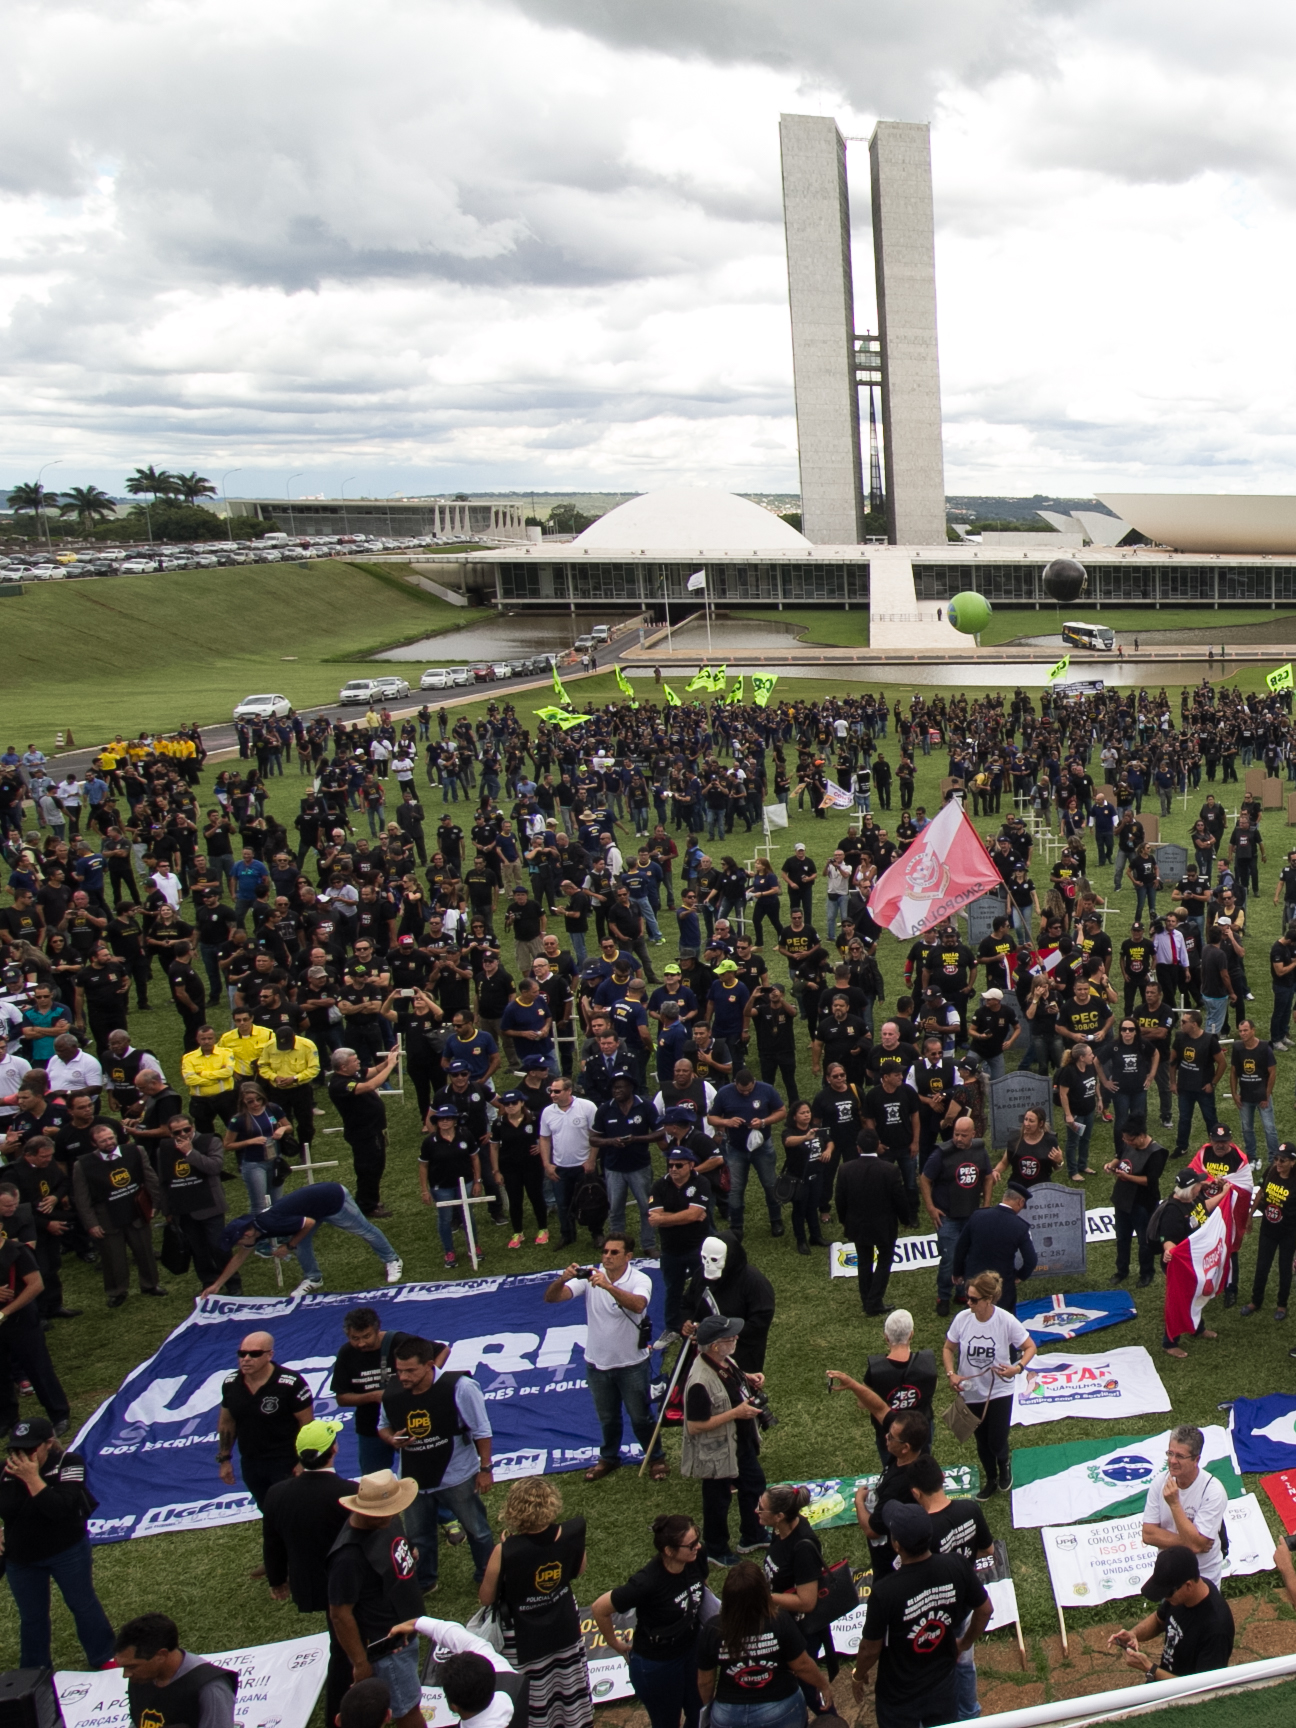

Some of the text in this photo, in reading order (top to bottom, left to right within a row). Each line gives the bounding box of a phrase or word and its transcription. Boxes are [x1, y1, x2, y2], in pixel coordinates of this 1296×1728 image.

[786, 937, 808, 946] PEC
[1071, 1011, 1098, 1023] PEC
[1074, 1021, 1098, 1030] 308/04
[1138, 1017, 1159, 1028] PEC
[1006, 1086, 1035, 1094] POLICIAL
[1021, 1159, 1037, 1168] PEC
[1206, 1162, 1230, 1172] UNIÃO
[959, 1167, 976, 1175] PEC
[1022, 1166, 1037, 1176] 287
[111, 1172, 130, 1183] UPB
[959, 1174, 977, 1184] 287
[1267, 1181, 1290, 1197] UNIÃO
[1028, 1201, 1065, 1210] POLICIAL
[1032, 1213, 1060, 1221] ENFIM
[1049, 1249, 1066, 1258] 287
[967, 1345, 996, 1358] UPB
[891, 1399, 916, 1409] 287
[1054, 1395, 1073, 1403] com
[100, 1442, 136, 1455] DOS
[519, 1384, 540, 1395] DE
[408, 1417, 430, 1428] UPB
[1228, 1507, 1246, 1515] PEC
[1230, 1513, 1248, 1521] 287
[1090, 1528, 1101, 1537] SE
[1102, 1527, 1110, 1536] O
[1056, 1537, 1078, 1546] UPB
[1087, 1533, 1126, 1546] COMO SE
[1099, 1541, 1140, 1556] ISSO É
[975, 1561, 994, 1570] 287
[1090, 1556, 1135, 1568] FORÇAS DE
[535, 1566, 562, 1583] UPB
[1102, 1566, 1134, 1576] UNIDAS
[831, 1622, 864, 1633] UNIDAS
[295, 1650, 319, 1662] PEC
[291, 1659, 316, 1670] 287
[60, 1687, 90, 1699] UPB
[92, 1700, 104, 1712] A
